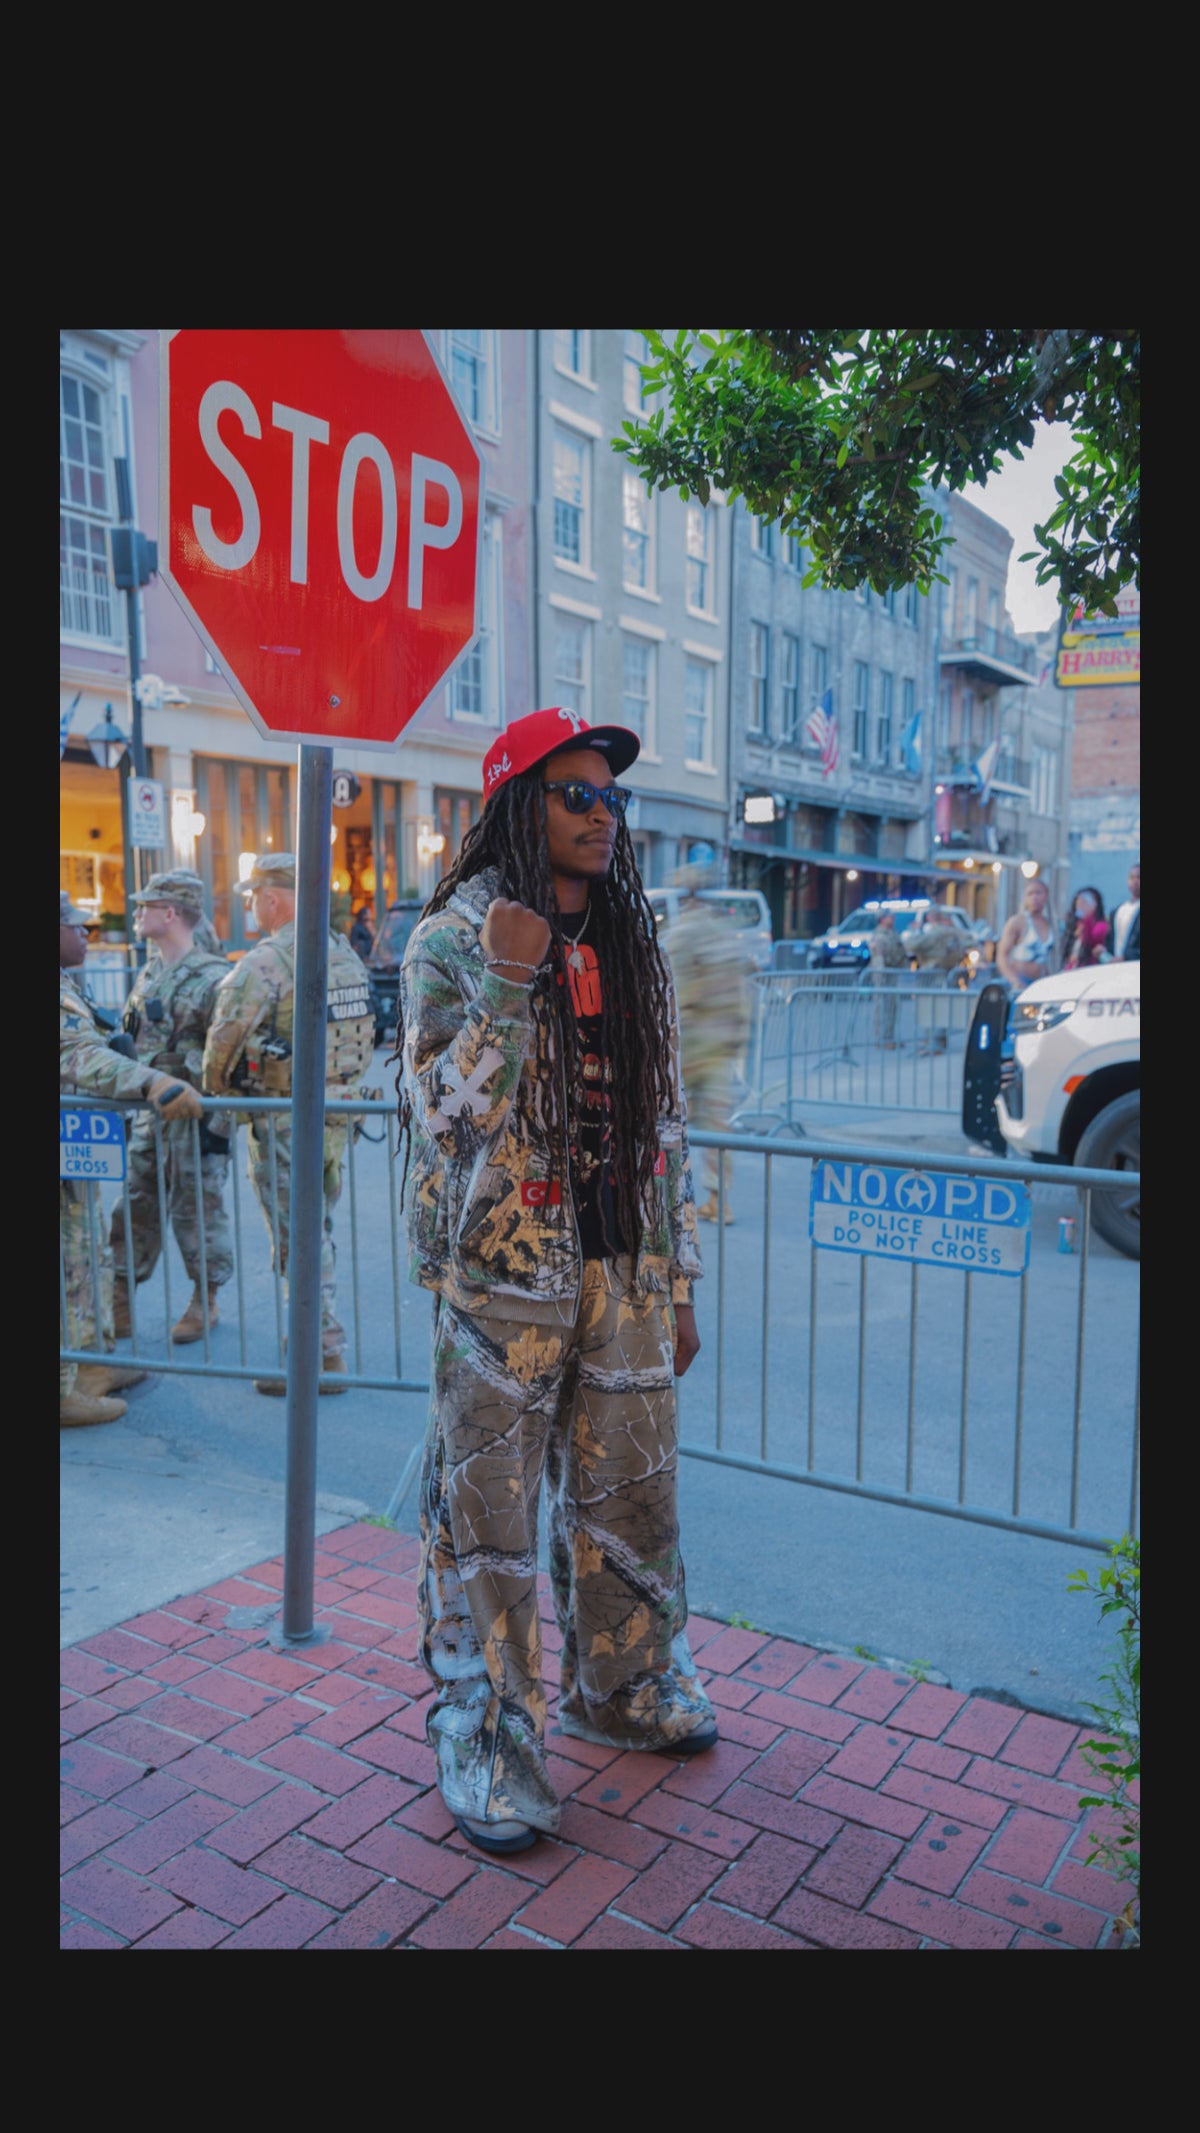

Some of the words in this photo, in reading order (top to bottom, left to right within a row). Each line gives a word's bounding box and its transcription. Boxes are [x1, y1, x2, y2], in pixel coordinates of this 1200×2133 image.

[192, 379, 463, 610] STOP
[65, 1145, 92, 1158] LINE
[65, 1160, 109, 1174] CROSS
[834, 1225, 862, 1244] DO
[876, 1232, 918, 1253] NOT
[931, 1240, 1002, 1265] CROSS
[848, 1210, 923, 1236] POLICE
[941, 1222, 989, 1245] LINE
